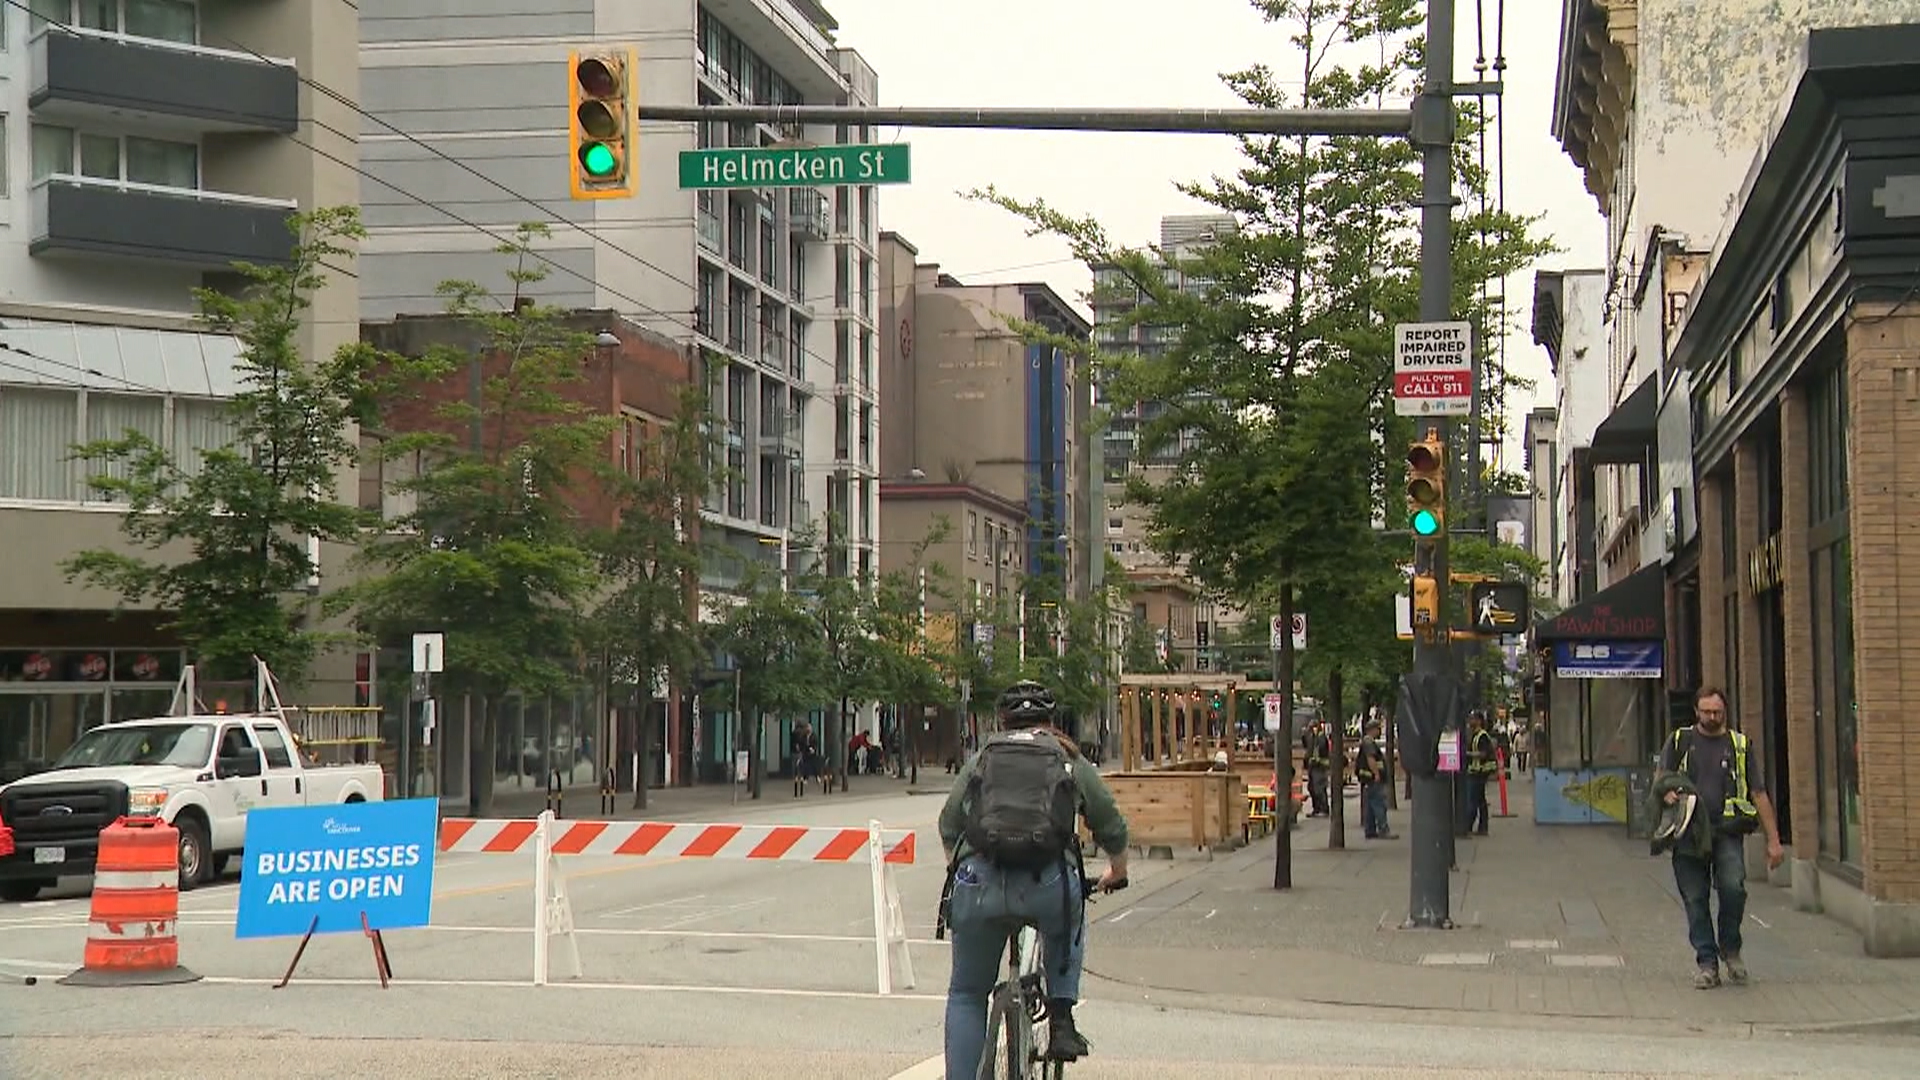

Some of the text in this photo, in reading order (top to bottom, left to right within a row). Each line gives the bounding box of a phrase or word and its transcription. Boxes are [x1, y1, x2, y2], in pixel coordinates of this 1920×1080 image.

[703, 151, 885, 182] Helmcken St
[1406, 329, 1460, 340] REPORT
[1401, 342, 1465, 353] IMPAIRED
[1403, 354, 1463, 365] DRIVERS
[1403, 382, 1463, 395] CALL 911
[1557, 617, 1656, 635] PAWN SHOP
[258, 845, 420, 875] BUSINESSES
[267, 875, 404, 905] ARE OPEN
